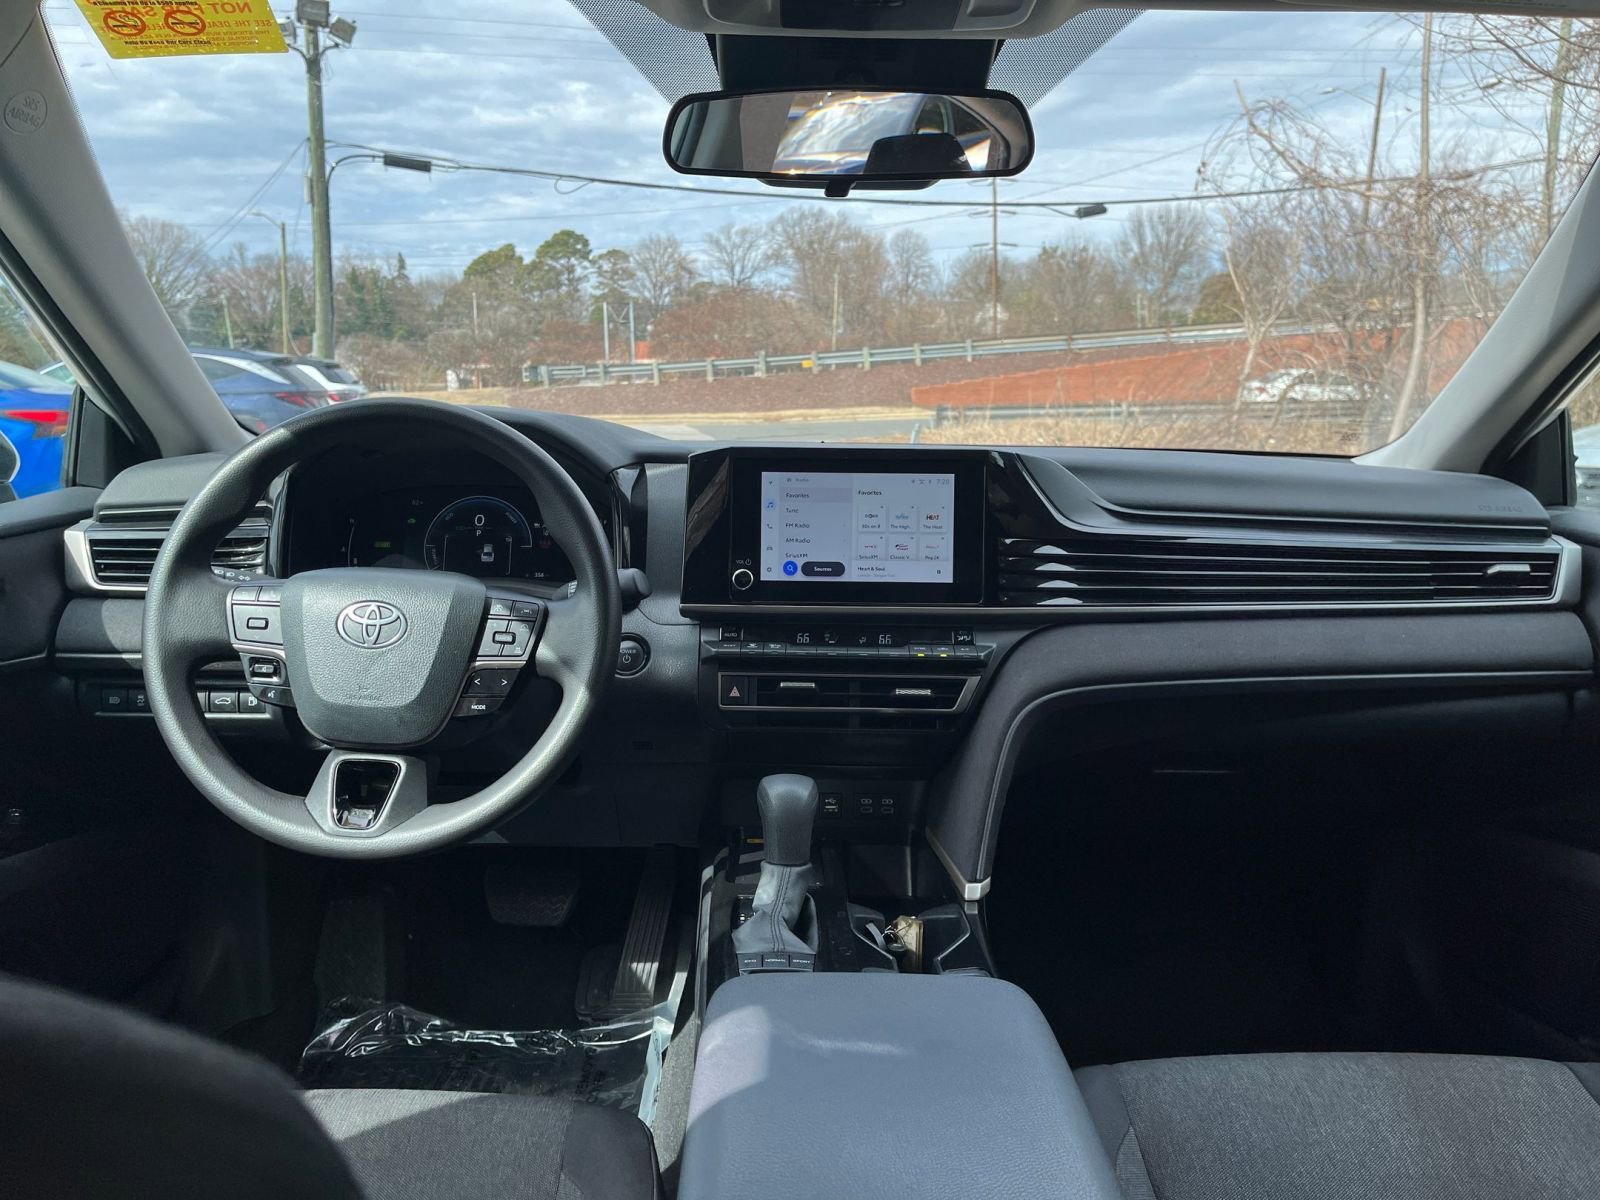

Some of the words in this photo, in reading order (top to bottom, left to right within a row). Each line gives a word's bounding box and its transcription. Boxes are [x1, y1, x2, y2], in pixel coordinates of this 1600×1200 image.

[7, 107, 41, 128] AIRBAG
[474, 514, 485, 526] 0
[796, 633, 810, 644] 66
[878, 634, 892, 645] 66
